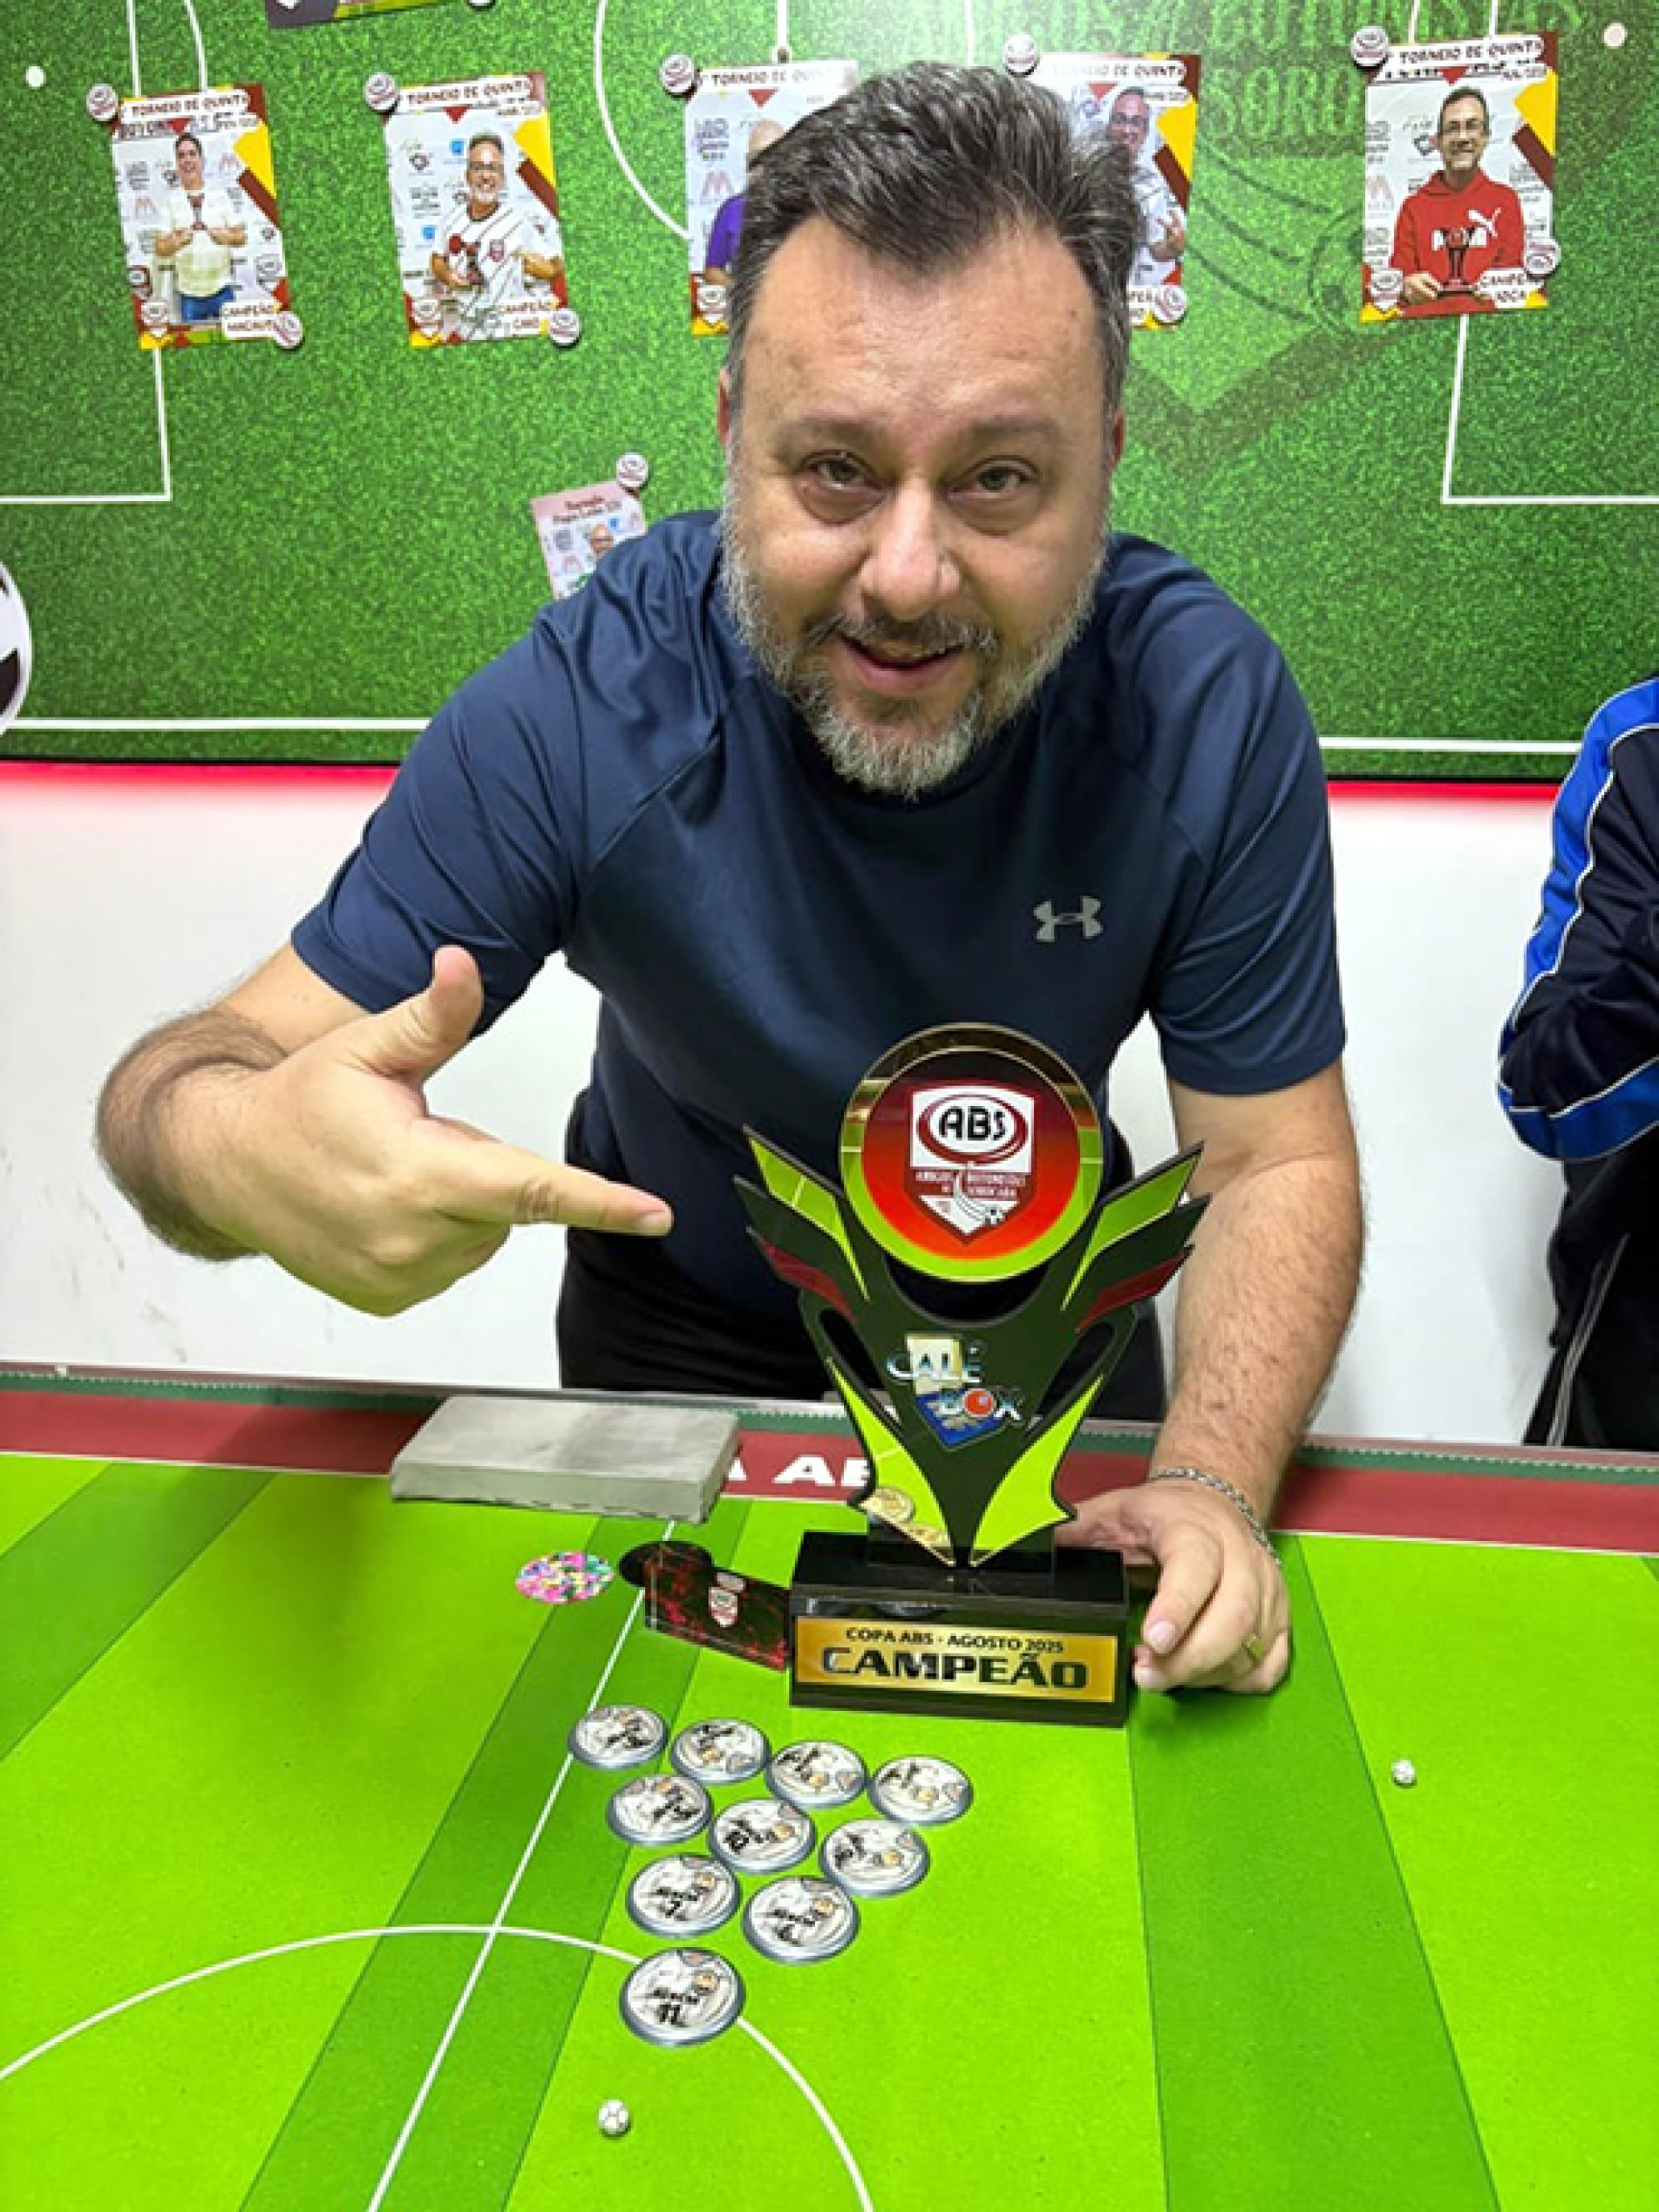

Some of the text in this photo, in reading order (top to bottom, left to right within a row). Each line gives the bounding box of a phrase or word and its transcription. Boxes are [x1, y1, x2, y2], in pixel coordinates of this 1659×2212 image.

[939, 1105, 1007, 1141] ABS
[845, 1626, 896, 1644] COPA
[900, 1631, 934, 1645] ABS
[947, 1633, 1023, 1652] AGOSTO
[821, 1645, 1090, 1690] CAMPEÃO
